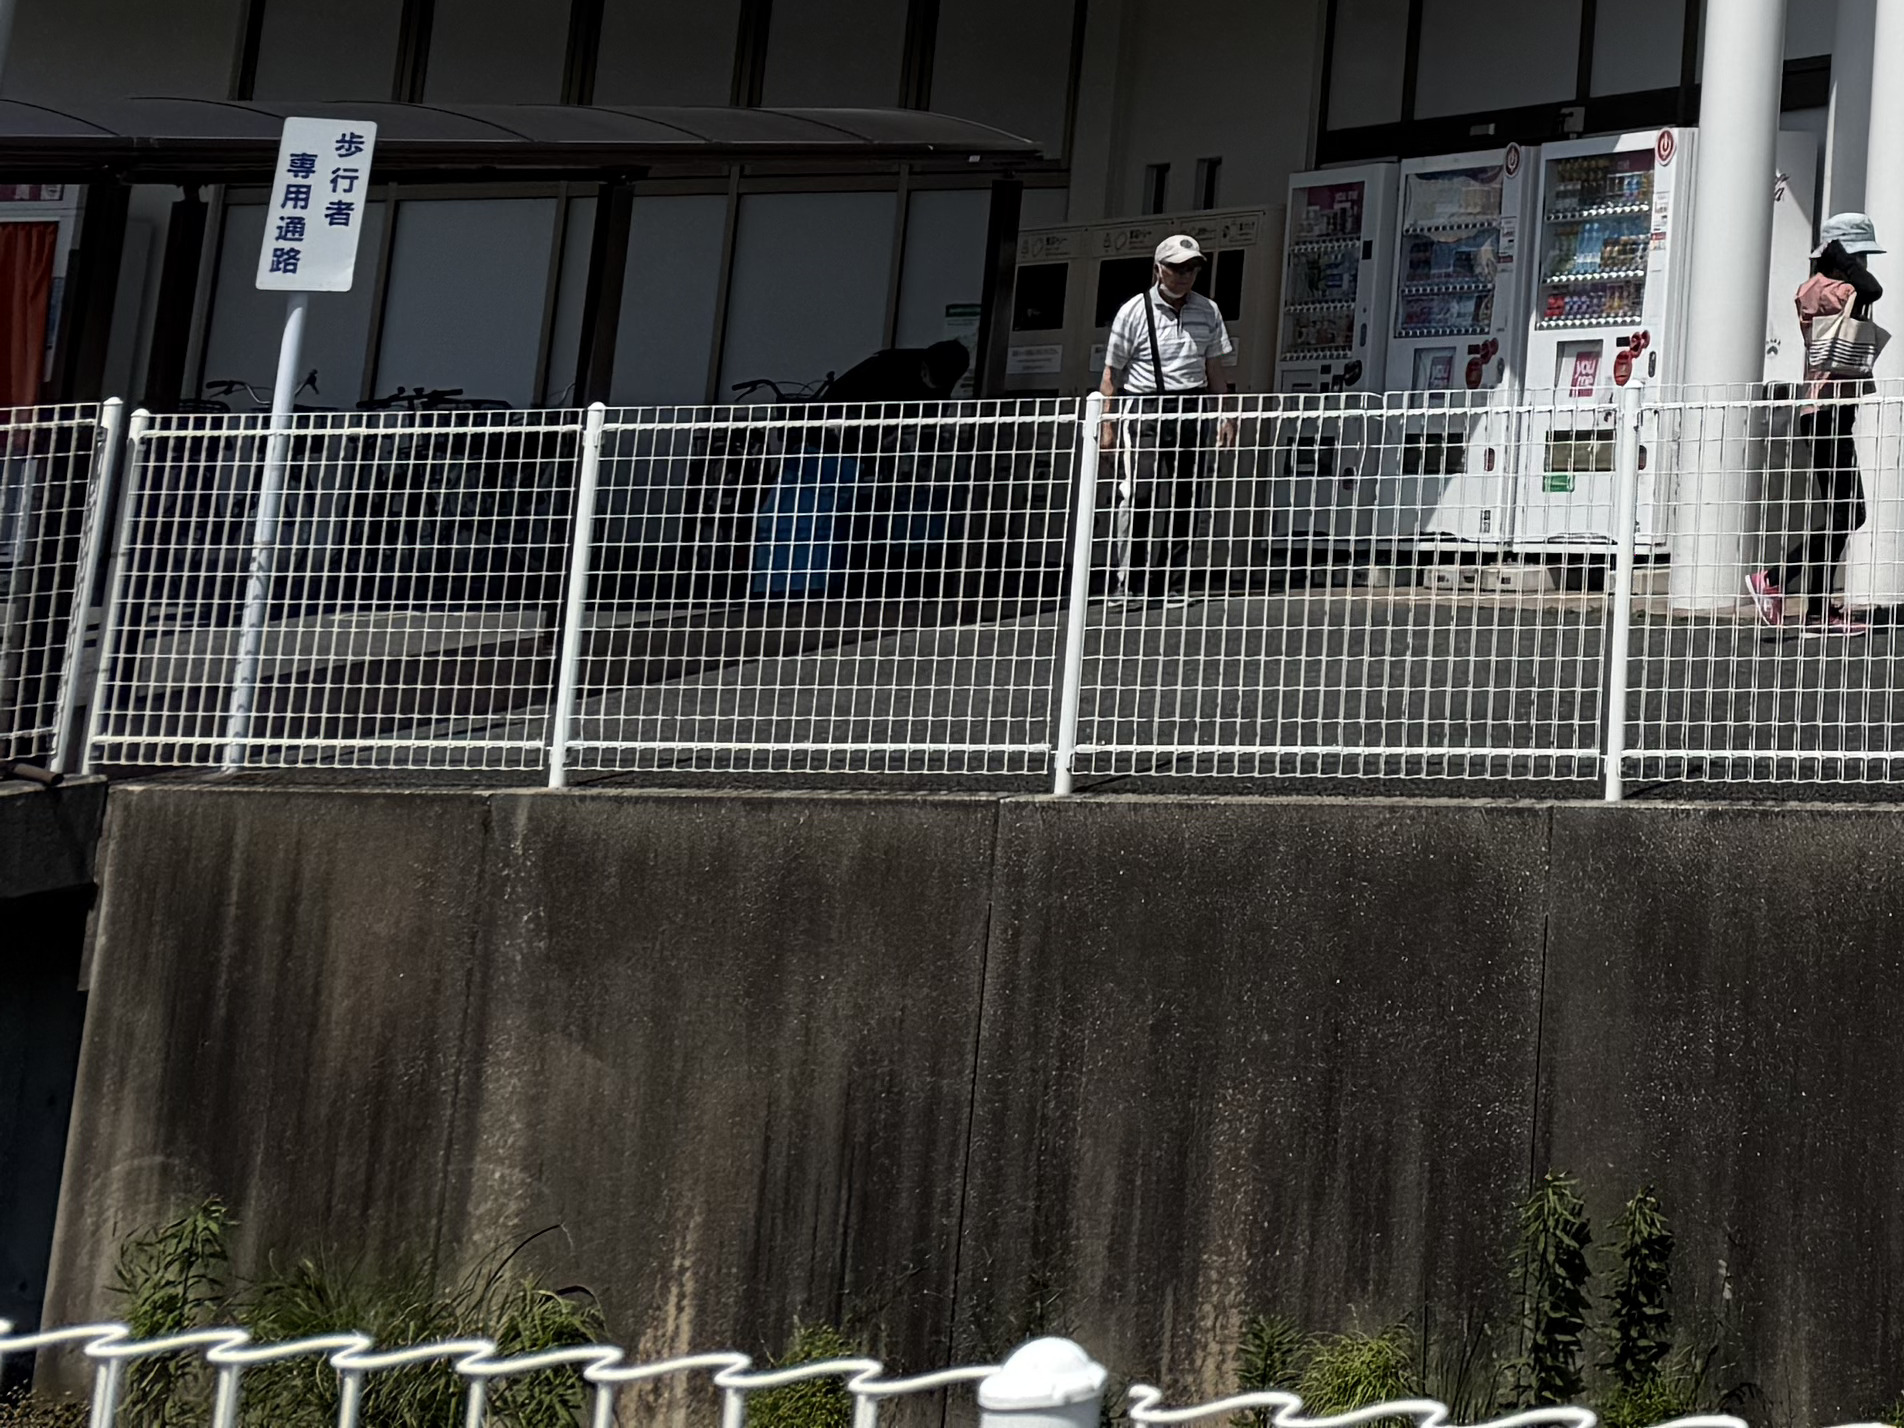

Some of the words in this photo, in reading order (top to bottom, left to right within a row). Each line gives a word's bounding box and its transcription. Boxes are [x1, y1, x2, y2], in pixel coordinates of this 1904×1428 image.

[269, 152, 318, 275] 専用通路
[324, 132, 365, 227] 歩行者
